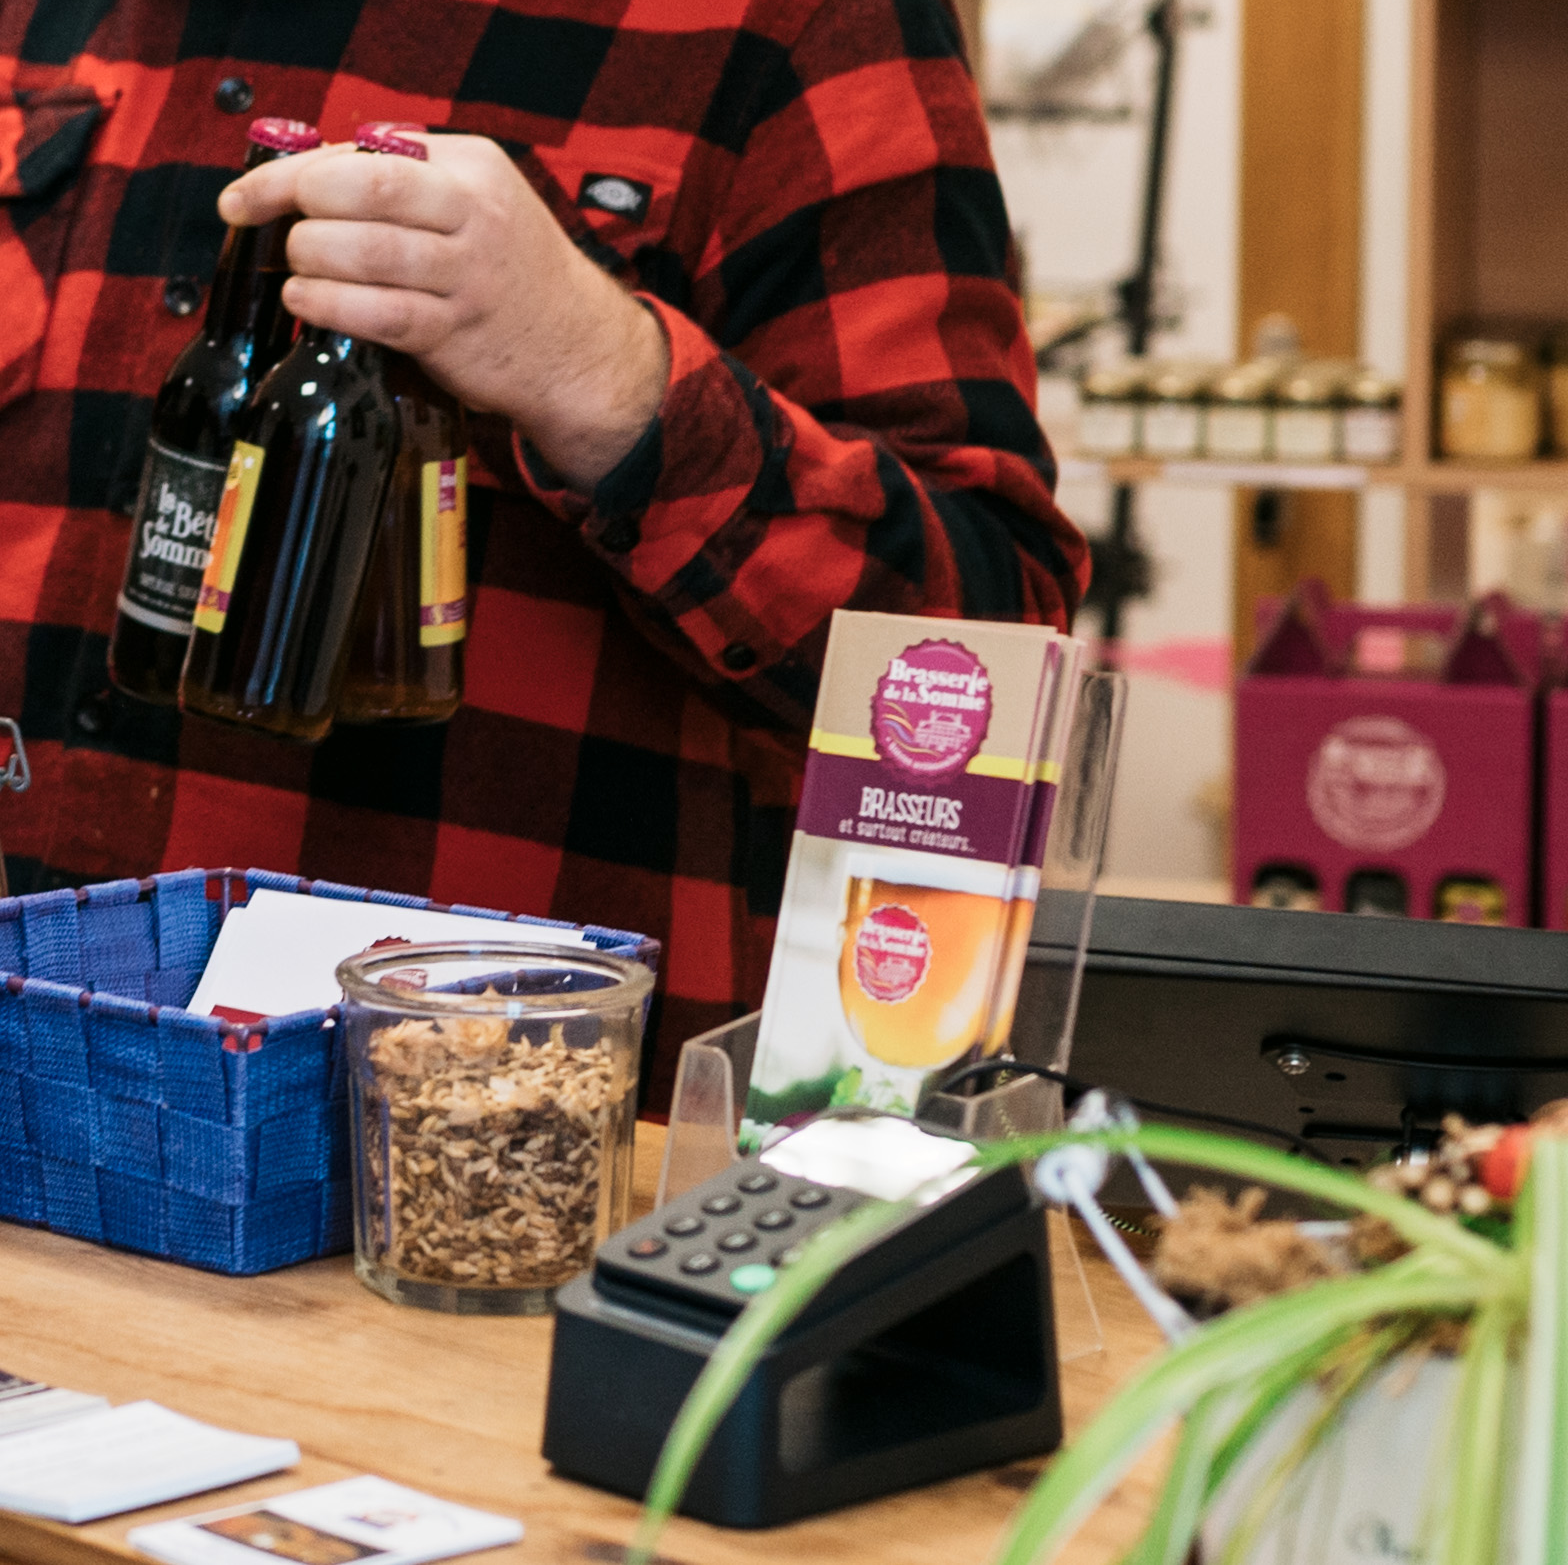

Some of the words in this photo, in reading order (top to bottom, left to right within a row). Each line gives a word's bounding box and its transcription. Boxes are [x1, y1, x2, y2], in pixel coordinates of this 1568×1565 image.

[886, 659, 988, 694] Brasserie
[917, 686, 987, 712] Somme
[858, 786, 963, 830] BRASSEURS
